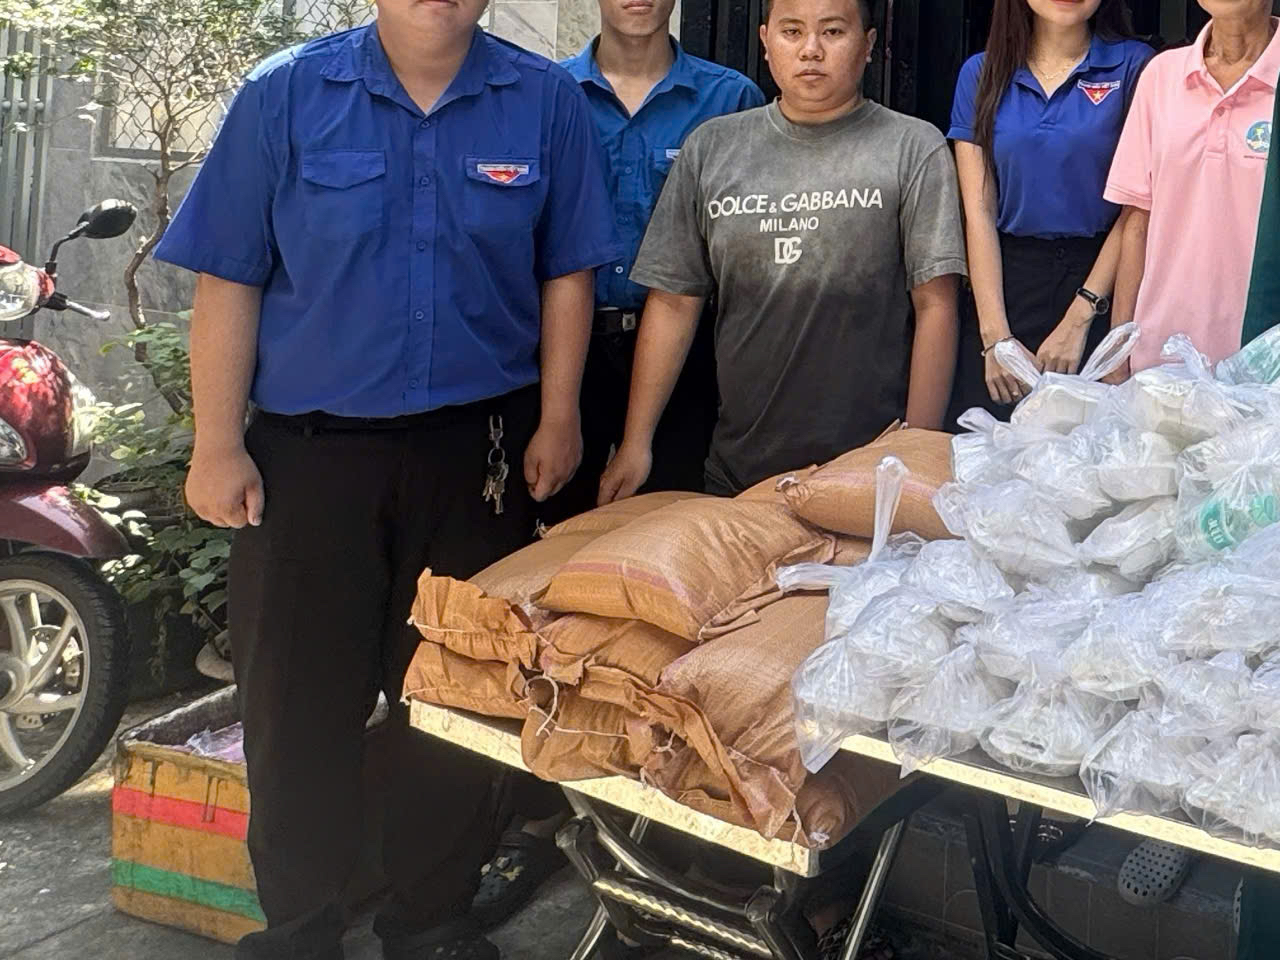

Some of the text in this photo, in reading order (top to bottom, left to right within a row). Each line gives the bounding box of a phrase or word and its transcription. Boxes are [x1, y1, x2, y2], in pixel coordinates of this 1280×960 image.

[708, 188, 883, 219] DOLCE & GABBANA
[759, 216, 820, 233] MILANO
[774, 236, 803, 264] DG
